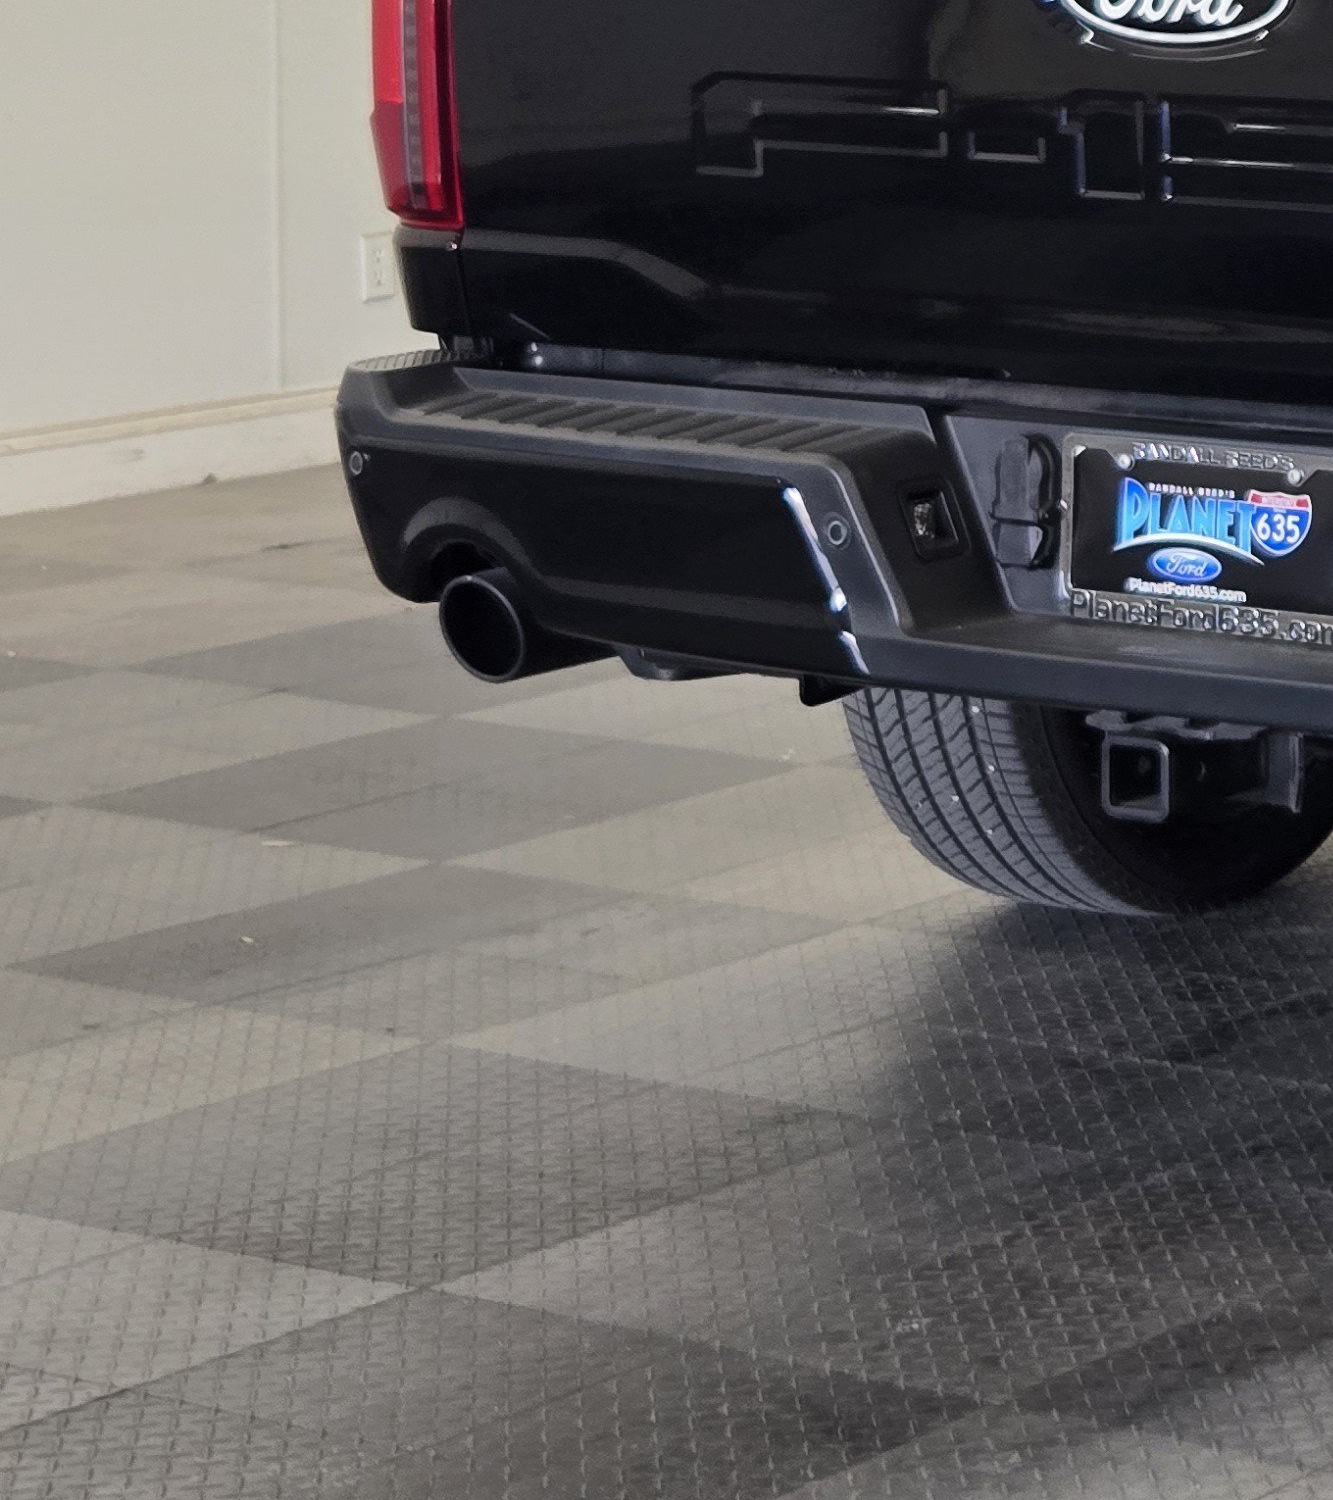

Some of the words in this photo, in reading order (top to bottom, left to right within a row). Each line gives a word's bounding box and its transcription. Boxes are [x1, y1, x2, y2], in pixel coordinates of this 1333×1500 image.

[1132, 442, 1221, 465] RANDALL
[1120, 477, 1257, 555] PLANET
[1257, 513, 1301, 544] 635
[1165, 553, 1209, 578] Ford
[1125, 576, 1247, 603] PlanetFord635.com
